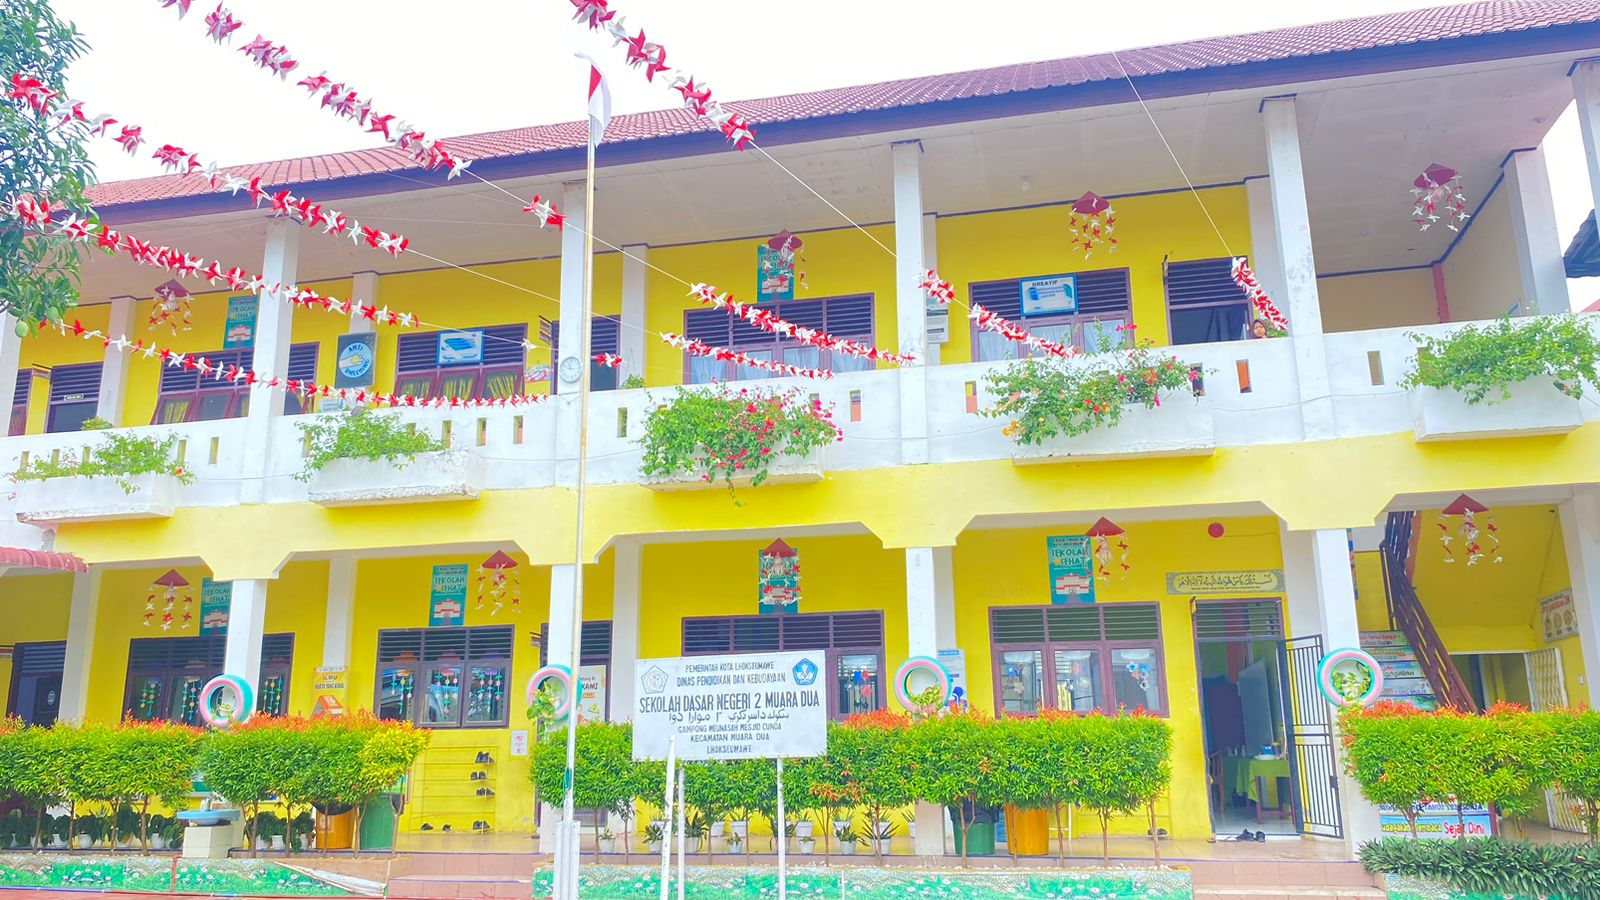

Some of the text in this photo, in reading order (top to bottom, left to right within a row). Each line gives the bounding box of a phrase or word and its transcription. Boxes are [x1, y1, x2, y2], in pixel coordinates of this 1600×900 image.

[685, 661, 775, 673] PEMERINTAH KOTA LHOKSEUMAWE
[676, 672, 786, 687] DINAS PENDIDIKAN DAN KEBUDAYAAN
[639, 690, 820, 713] SEKOLAH DASAR NEGERI 2 MUARA DUA
[677, 725, 707, 734] GAMPONG
[708, 723, 738, 733] MEUNASAH
[740, 723, 761, 731] MESJID
[690, 732, 770, 743] KECAMATAN MUARA DUA
[706, 744, 752, 754] LHOKSEUMAWE
[1468, 822, 1485, 834] Dini
